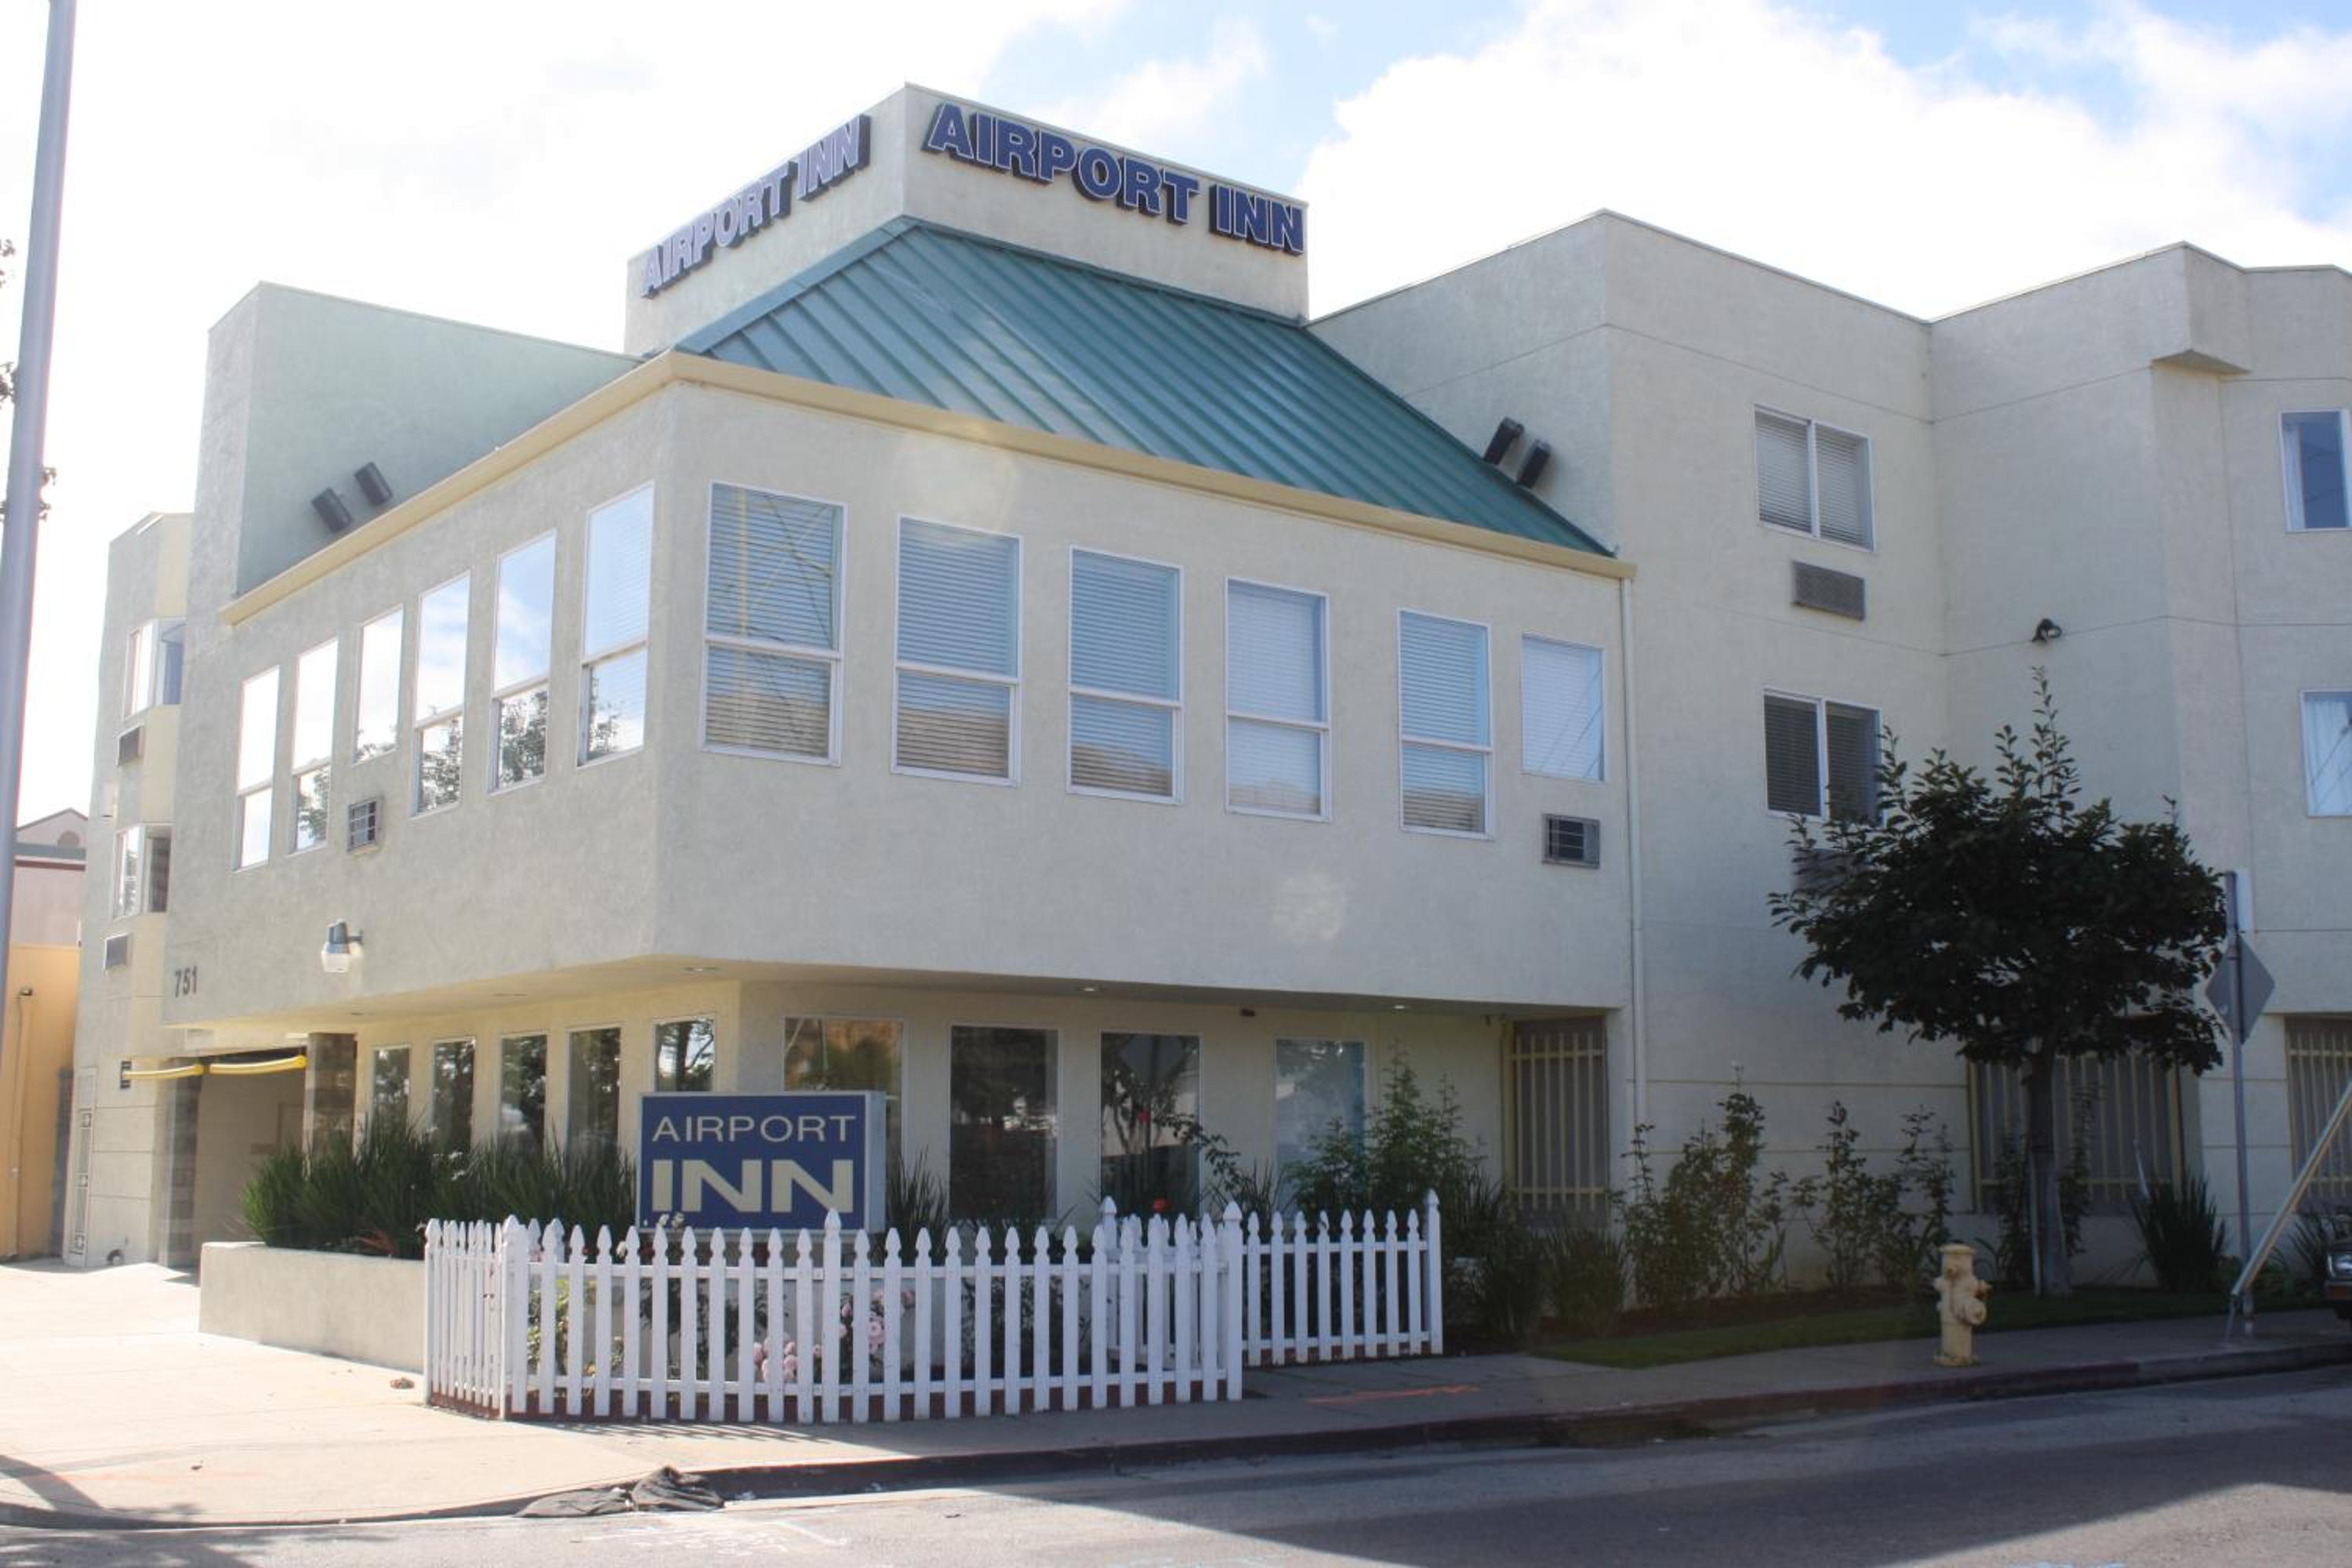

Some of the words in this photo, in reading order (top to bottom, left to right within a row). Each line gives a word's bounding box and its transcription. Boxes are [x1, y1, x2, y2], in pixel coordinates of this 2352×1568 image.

[924, 102, 1200, 223] AIRPORT
[1210, 184, 1306, 255] INN
[641, 160, 797, 298] AIRPORT
[795, 114, 869, 201] INN
[174, 964, 198, 998] 751
[652, 1115, 856, 1142] AIRPORT
[652, 1159, 854, 1213] INN
